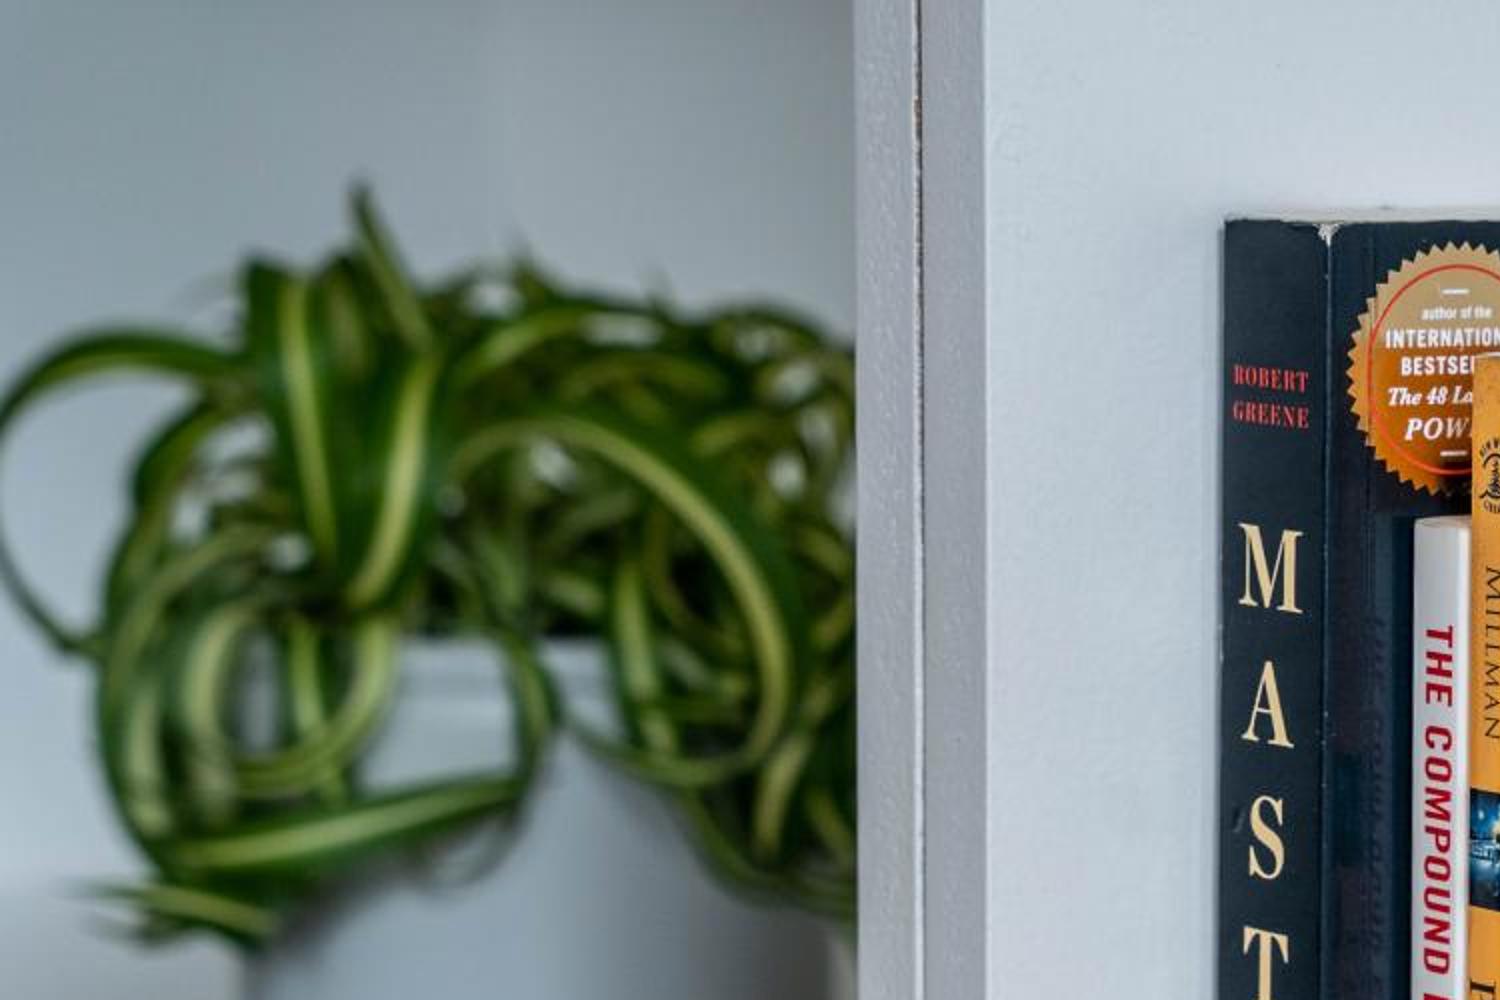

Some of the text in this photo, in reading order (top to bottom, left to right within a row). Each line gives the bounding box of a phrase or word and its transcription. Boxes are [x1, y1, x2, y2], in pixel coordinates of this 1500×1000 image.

[1421, 304, 1493, 321] author of the
[1233, 365, 1309, 392] ROBERT
[1401, 355, 1475, 376] BESTSE
[1387, 384, 1473, 407] The 48 La
[1232, 401, 1309, 428] GREENE
[1404, 417, 1473, 442] POW
[1424, 625, 1454, 708] THE
[1423, 724, 1453, 976] COMPOUND
